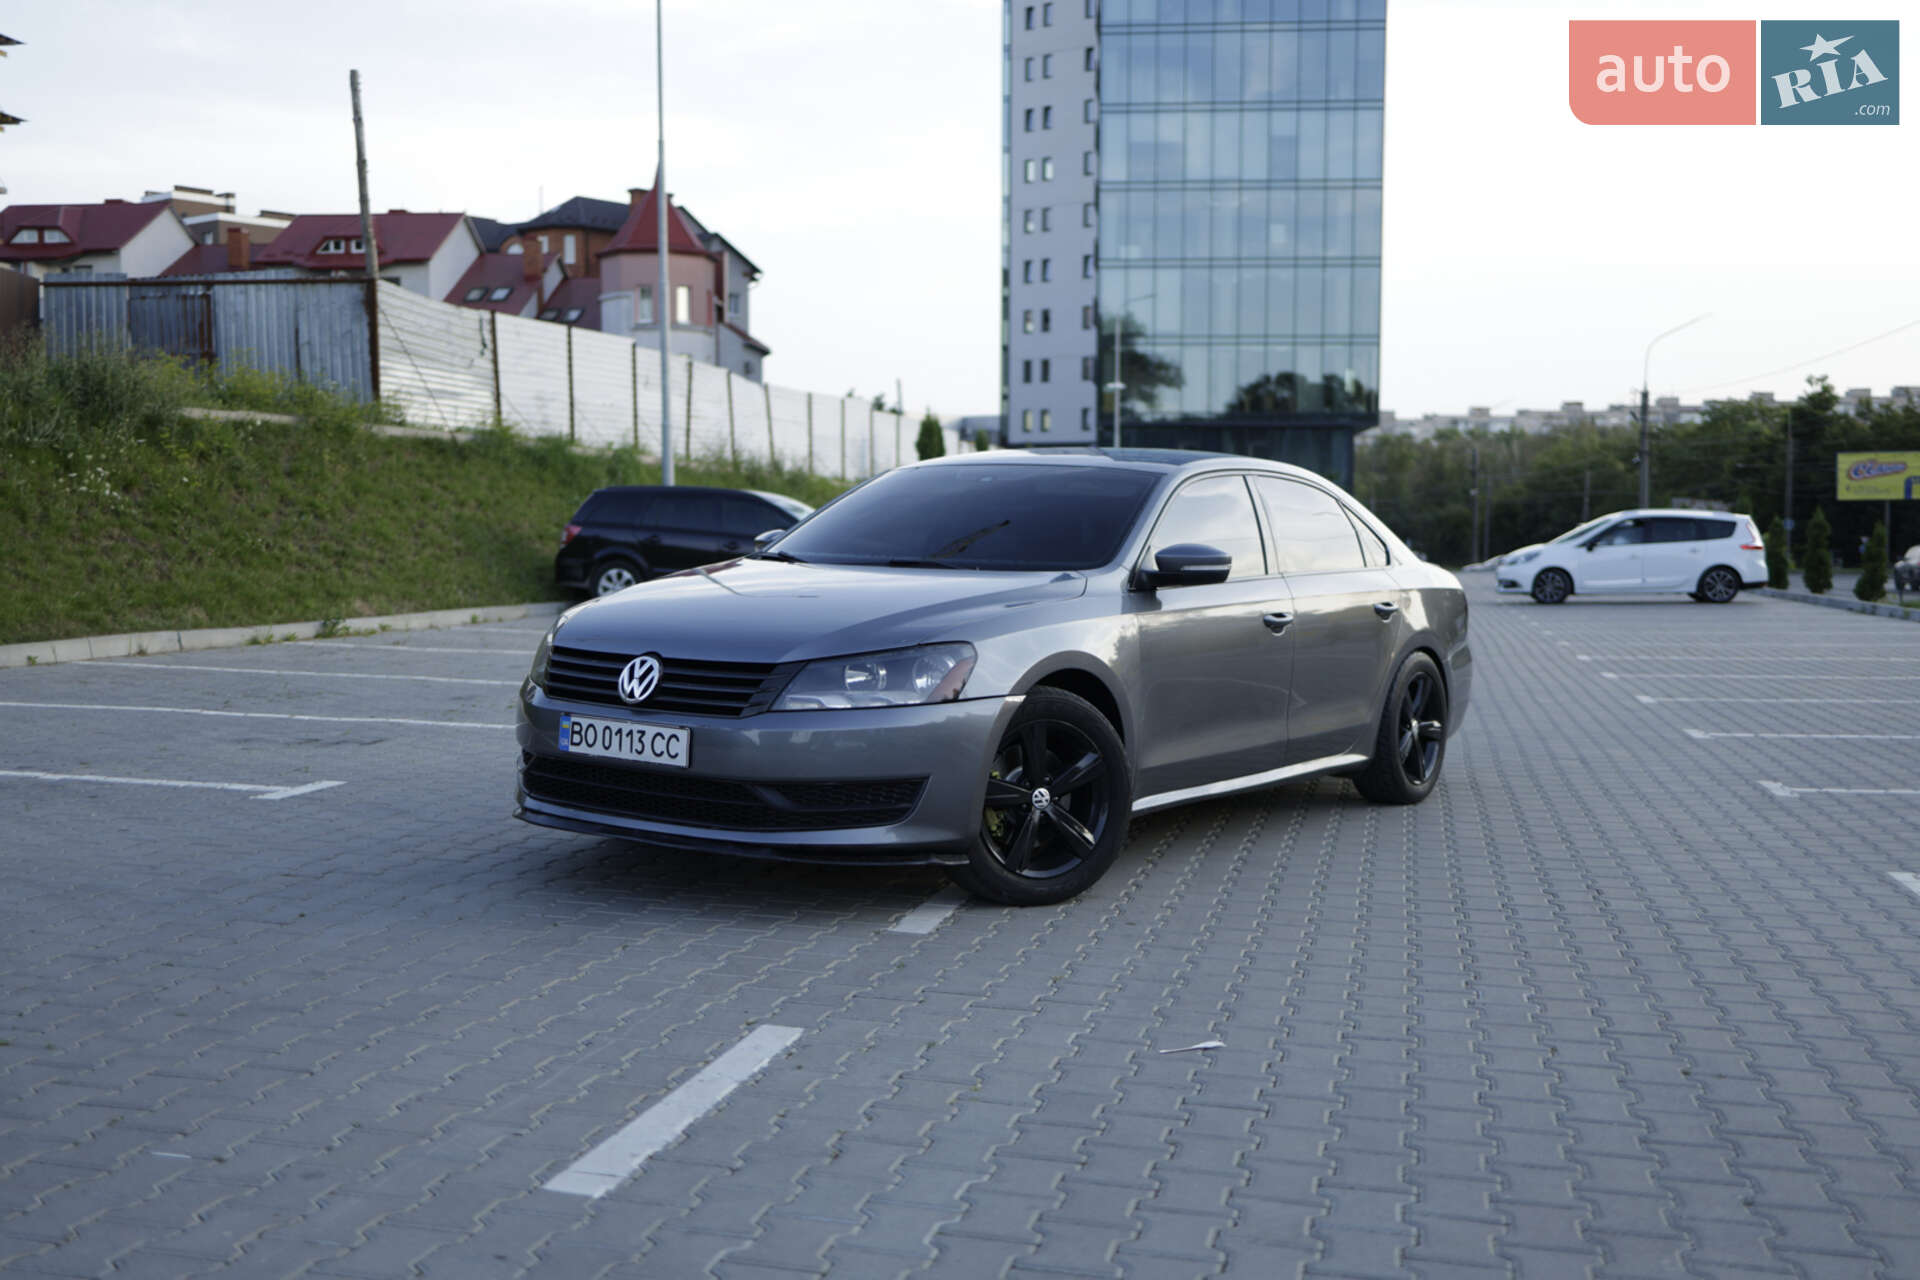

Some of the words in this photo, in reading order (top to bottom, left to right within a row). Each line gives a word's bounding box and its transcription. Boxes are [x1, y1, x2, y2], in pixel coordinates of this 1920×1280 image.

[620, 656, 658, 702] VW
[570, 721, 597, 748] BO
[602, 725, 646, 755] 0113
[651, 732, 680, 759] CC
